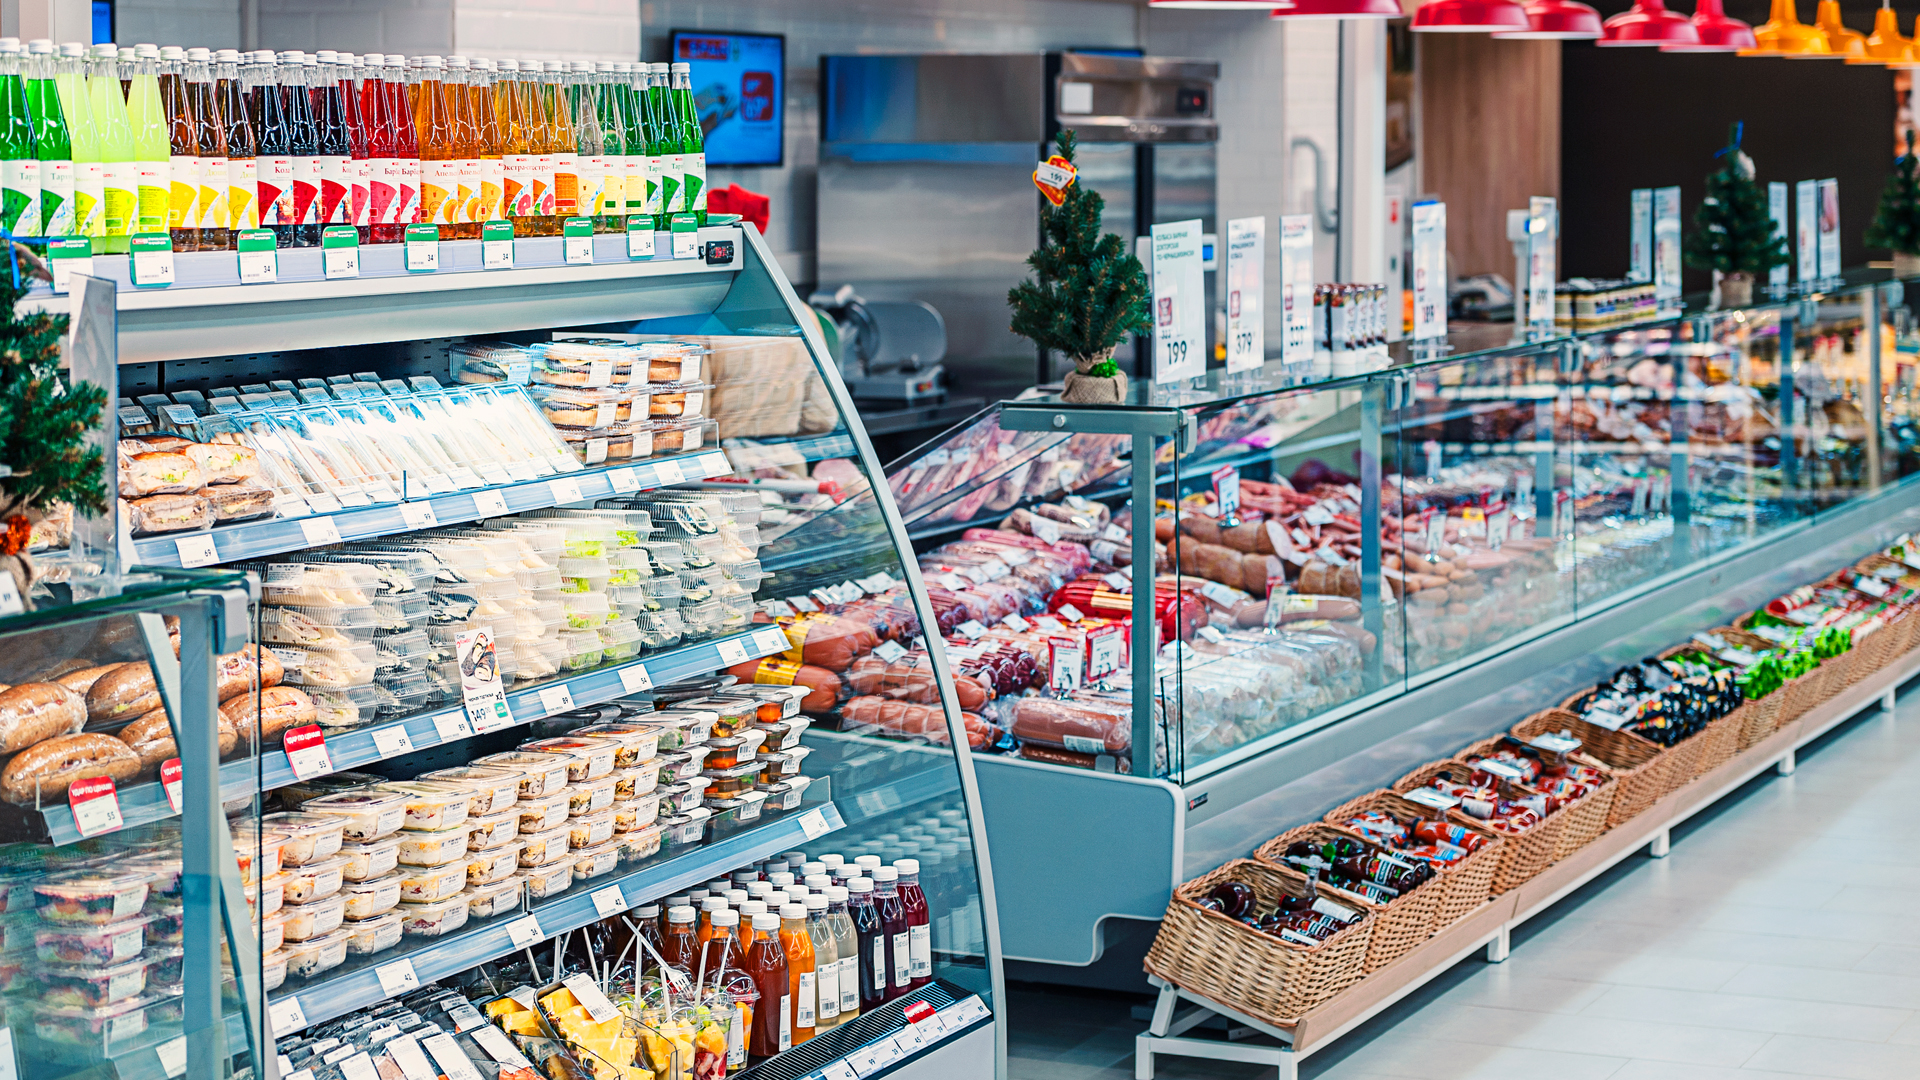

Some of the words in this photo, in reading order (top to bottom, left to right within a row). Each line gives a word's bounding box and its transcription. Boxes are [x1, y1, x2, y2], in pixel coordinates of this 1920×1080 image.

[1167, 340, 1187, 365] 199
[318, 760, 327, 768] 55
[107, 812, 116, 821] 55
[290, 1012, 299, 1021] 33
